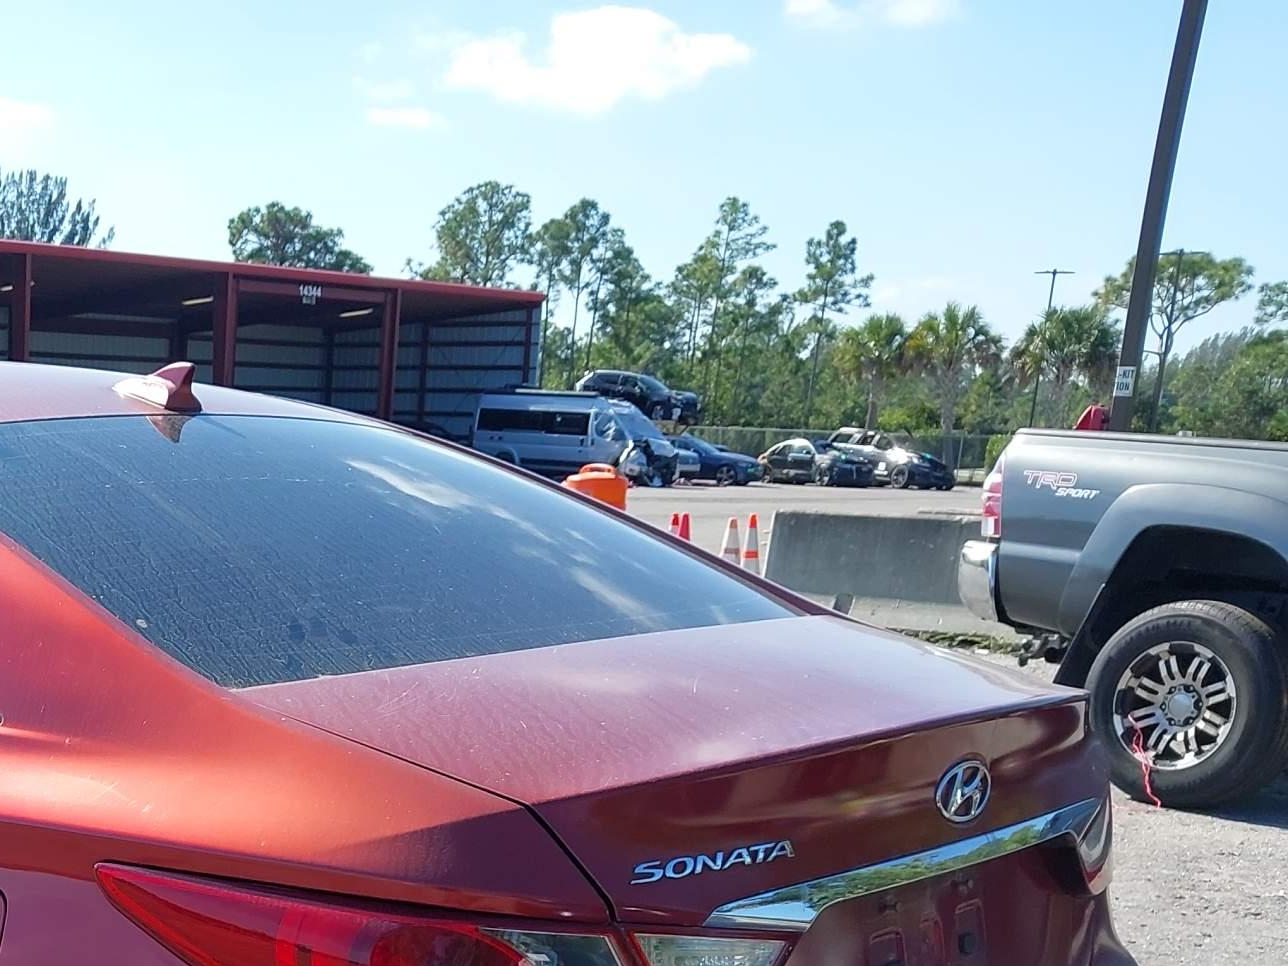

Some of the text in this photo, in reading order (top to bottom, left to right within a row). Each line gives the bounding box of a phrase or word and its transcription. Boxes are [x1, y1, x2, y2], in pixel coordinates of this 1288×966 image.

[1023, 469, 1078, 491] TRD
[1055, 486, 1101, 500] SPORT
[630, 839, 795, 885] SONATA
